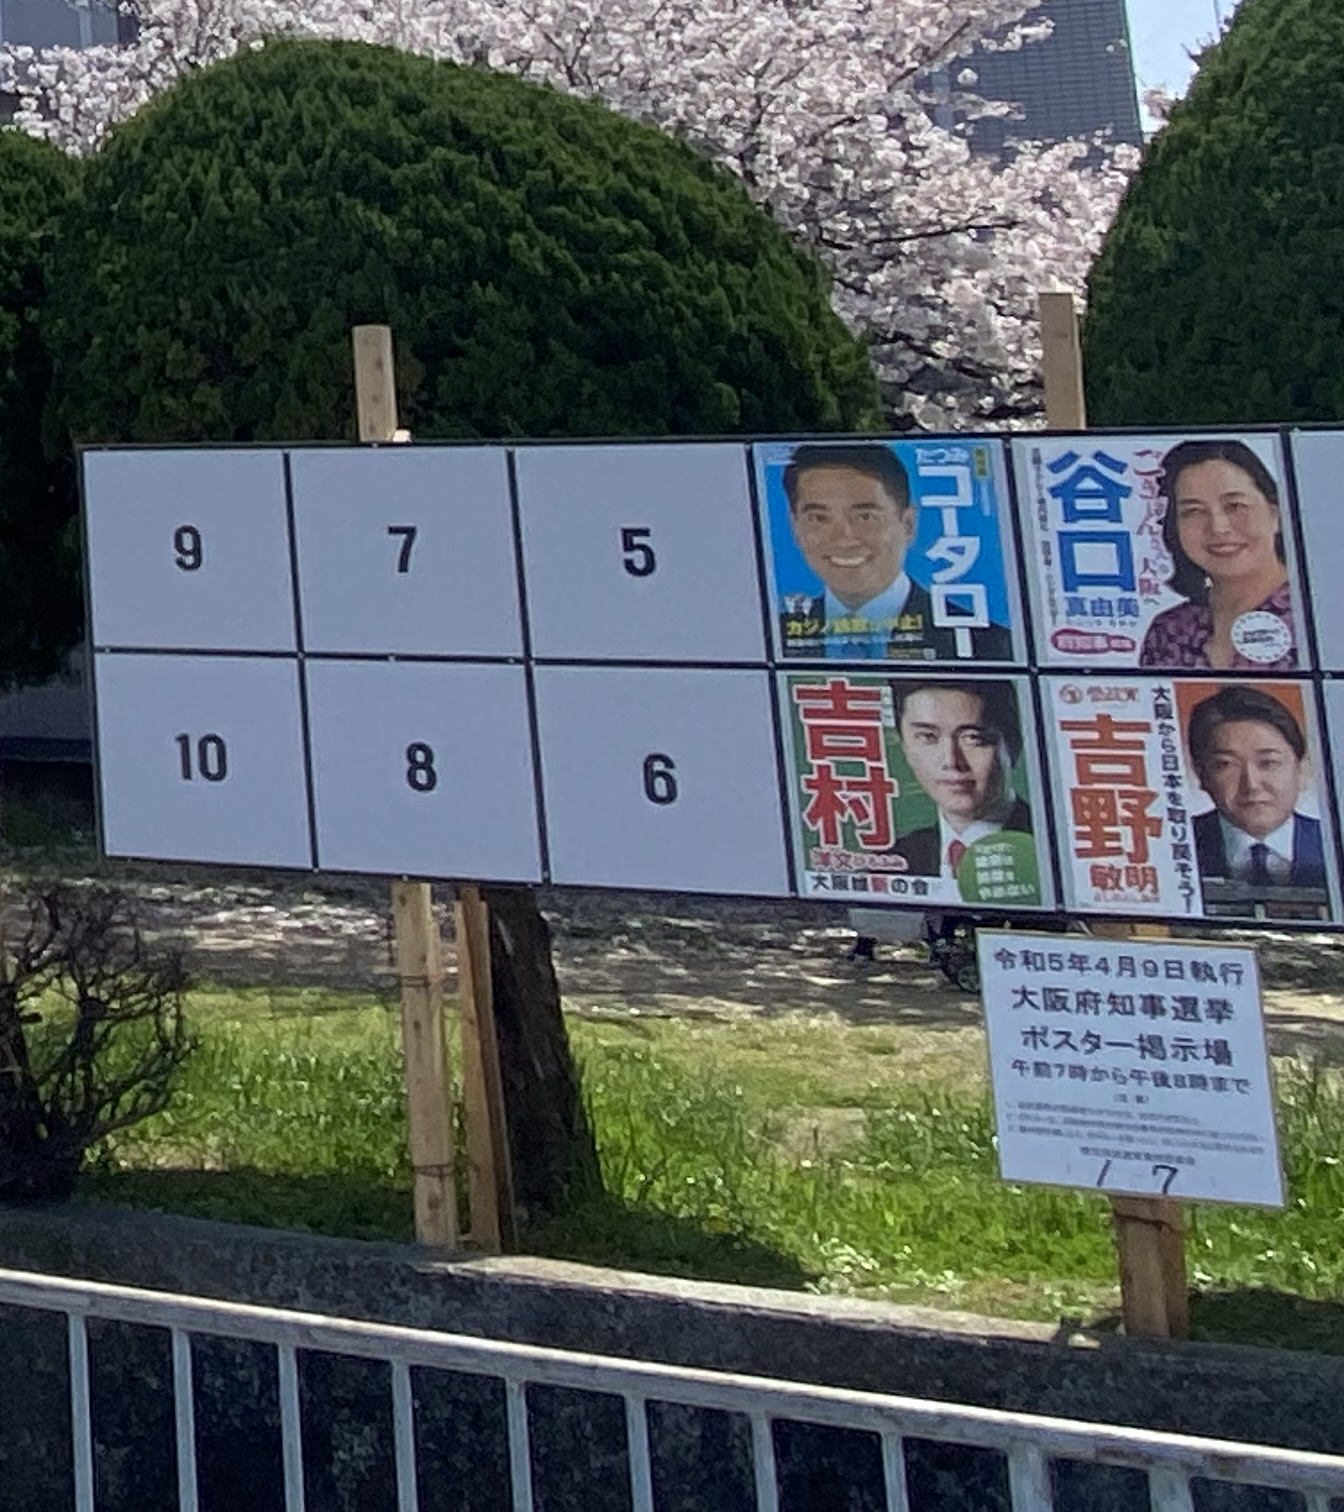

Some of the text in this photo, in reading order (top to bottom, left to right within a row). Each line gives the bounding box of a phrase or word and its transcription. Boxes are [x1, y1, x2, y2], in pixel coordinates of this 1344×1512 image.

[1045, 449, 1138, 594] 谷口
[173, 524, 203, 571] 9
[387, 525, 417, 574] 7
[620, 527, 657, 577] 5
[917, 465, 991, 658] コータロー
[175, 732, 228, 783] 10
[404, 741, 438, 792] 8
[642, 753, 679, 806] 6
[793, 678, 898, 849] 吉村
[1059, 712, 1163, 865] 吉野
[994, 947, 1244, 987] 令和5年4月9日執行
[1011, 984, 1234, 1025] 大阪府知事選挙
[1021, 1025, 1234, 1068] ポスター掲示場
[1011, 1058, 1252, 1096] 午前7時から午後8時まで
[1151, 1163, 1179, 1194] 7
